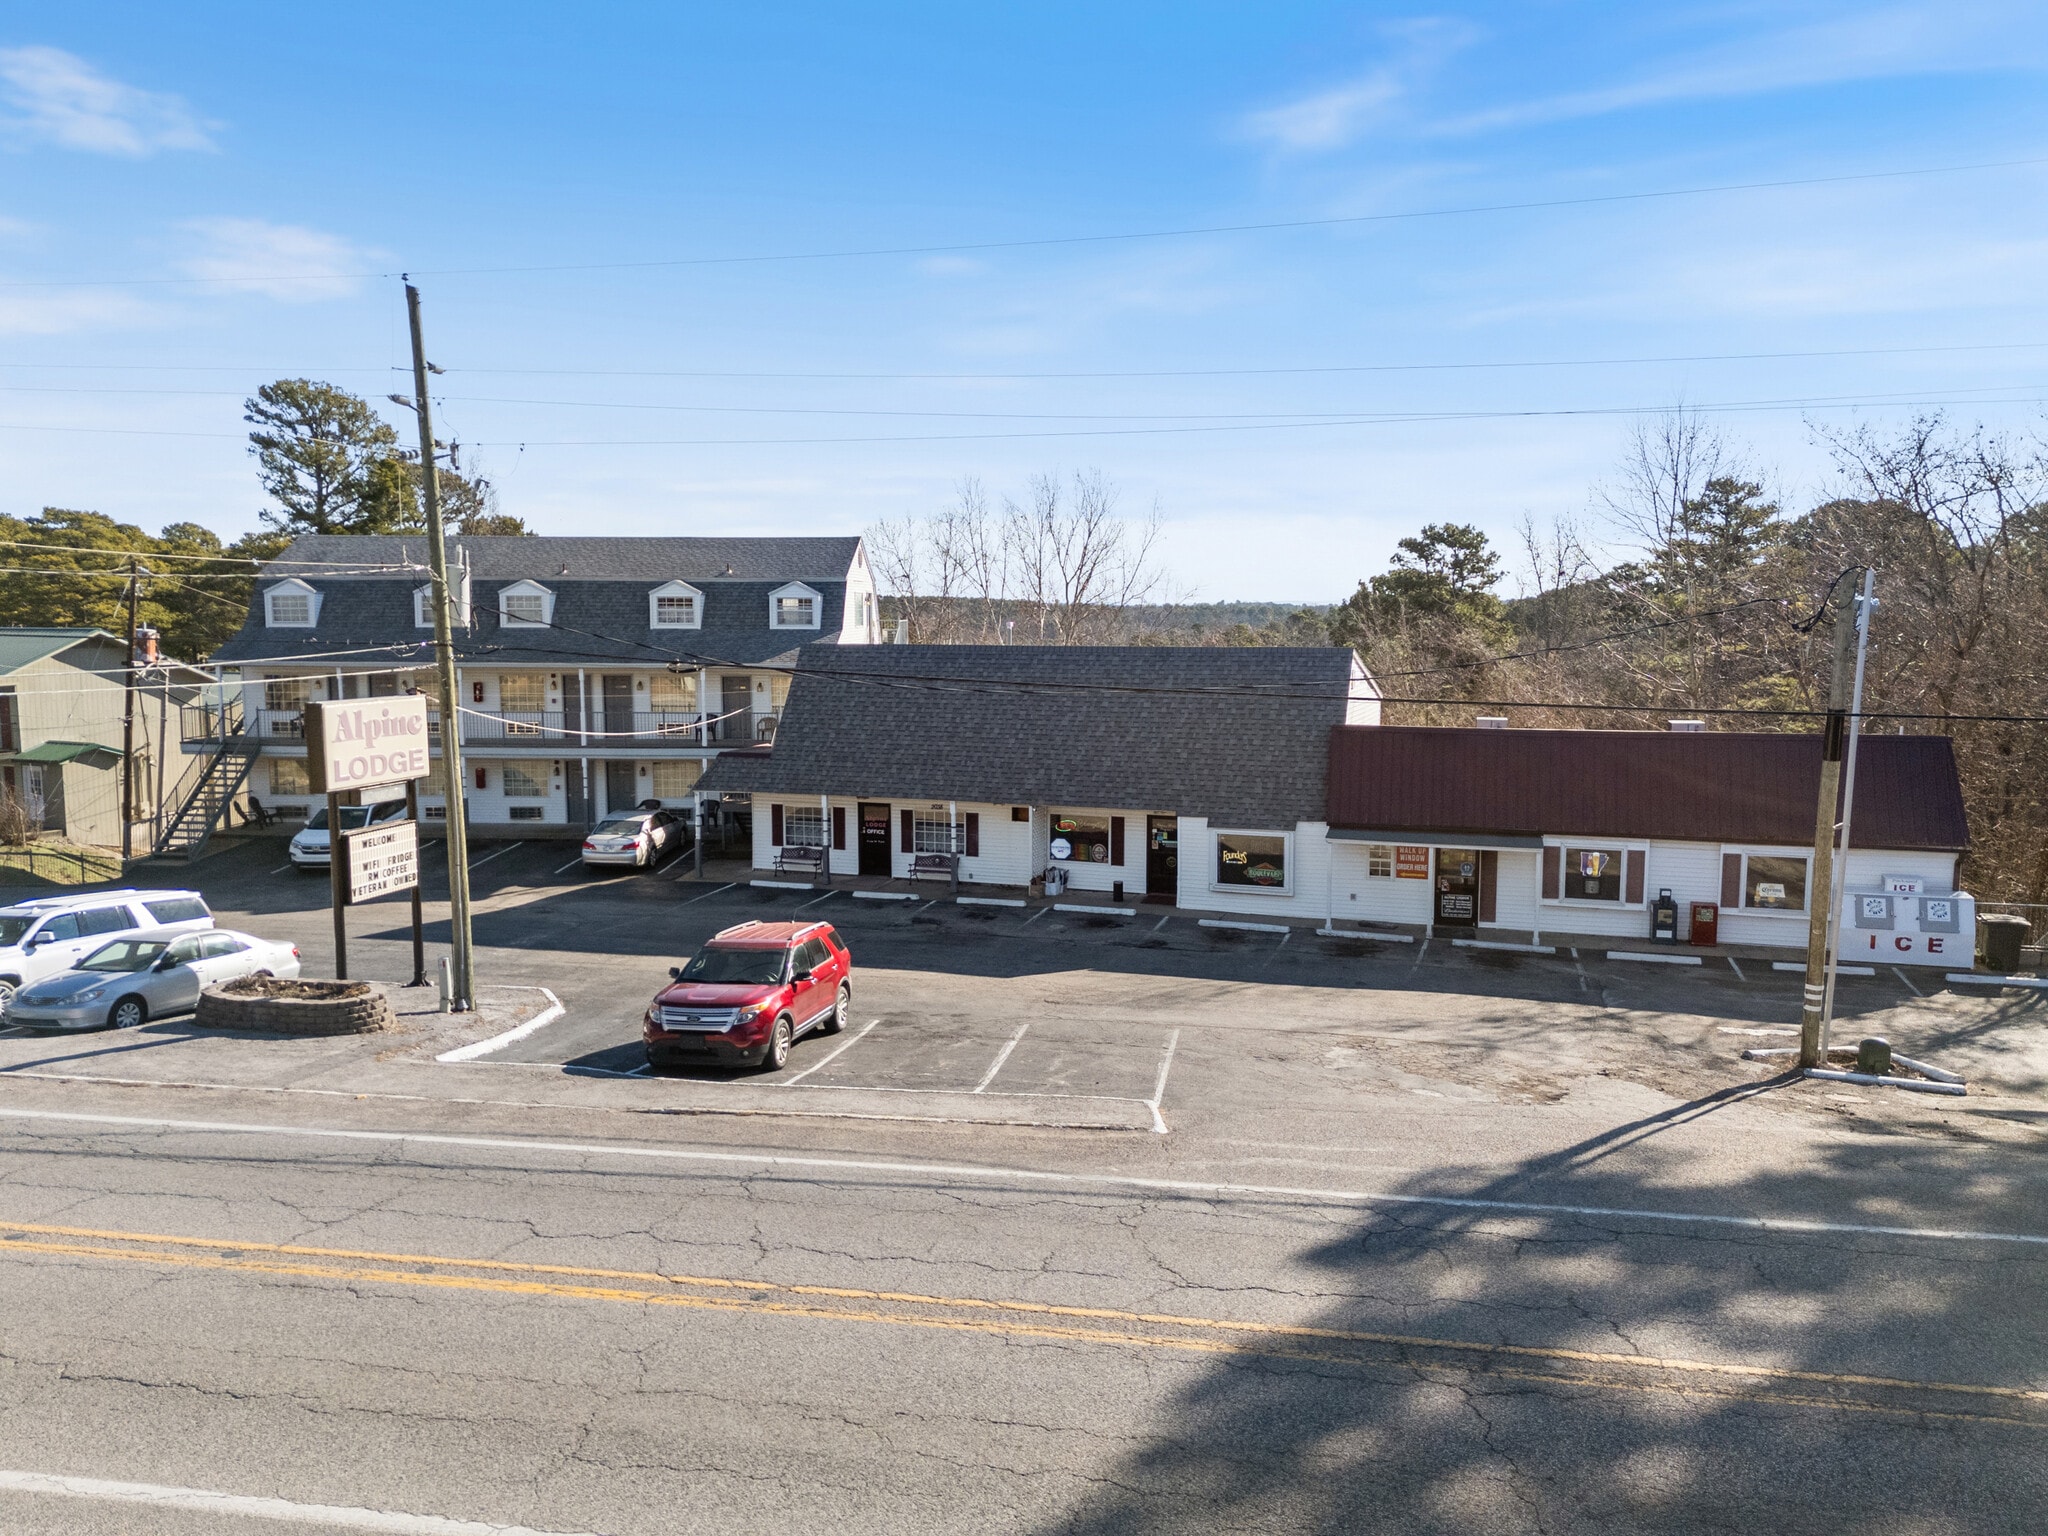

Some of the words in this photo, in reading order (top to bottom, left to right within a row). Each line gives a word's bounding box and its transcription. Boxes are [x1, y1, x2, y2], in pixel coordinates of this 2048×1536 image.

[332, 708, 422, 749] Alpine
[334, 748, 424, 783] LODGE
[362, 833, 395, 848] WELCOME
[362, 860, 379, 871] WIFI
[388, 851, 413, 865] FRIDGE
[368, 871, 378, 880] RM
[383, 864, 407, 877] COFFEE
[352, 880, 387, 897] VETERAN
[394, 872, 416, 886] OWNED
[1893, 884, 1915, 892] ICE
[1870, 934, 1944, 954] ICE
